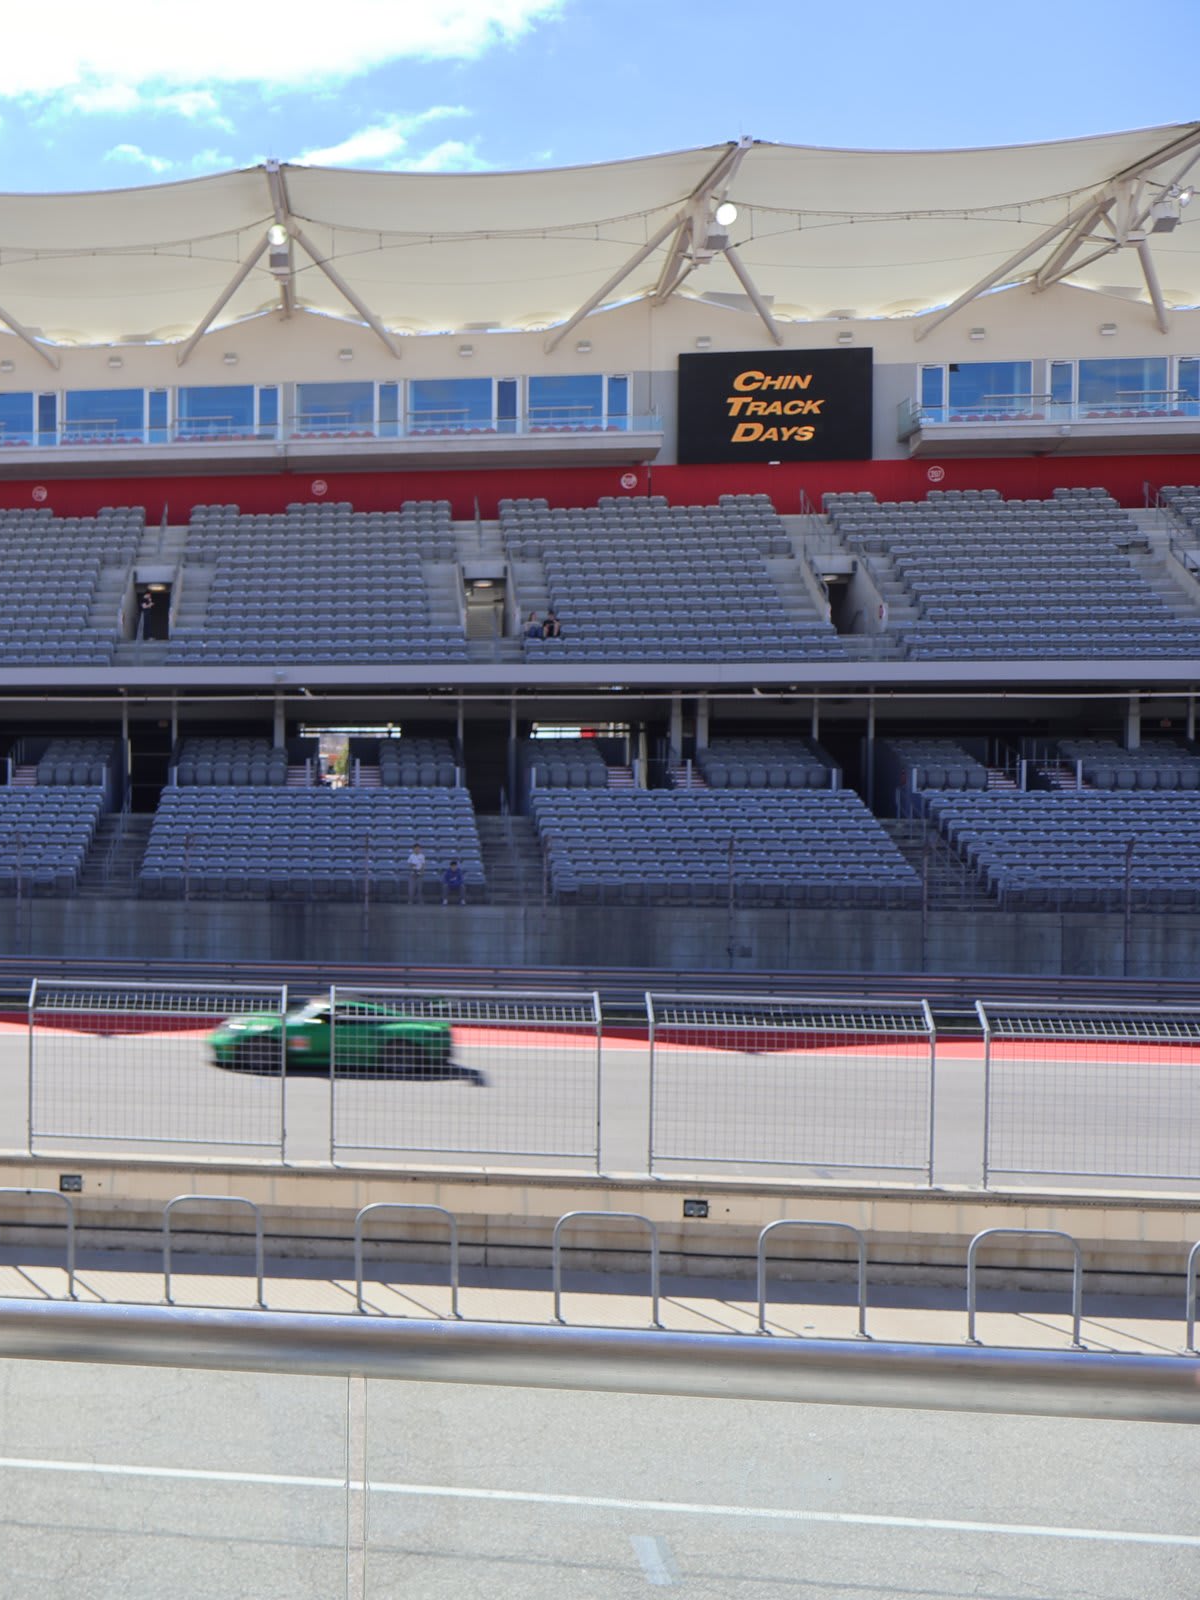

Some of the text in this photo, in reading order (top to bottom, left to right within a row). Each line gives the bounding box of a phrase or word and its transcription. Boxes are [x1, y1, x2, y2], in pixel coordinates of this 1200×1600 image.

[732, 370, 813, 391] CHIN
[726, 396, 826, 417] TRACK
[730, 422, 816, 443] DAYS
